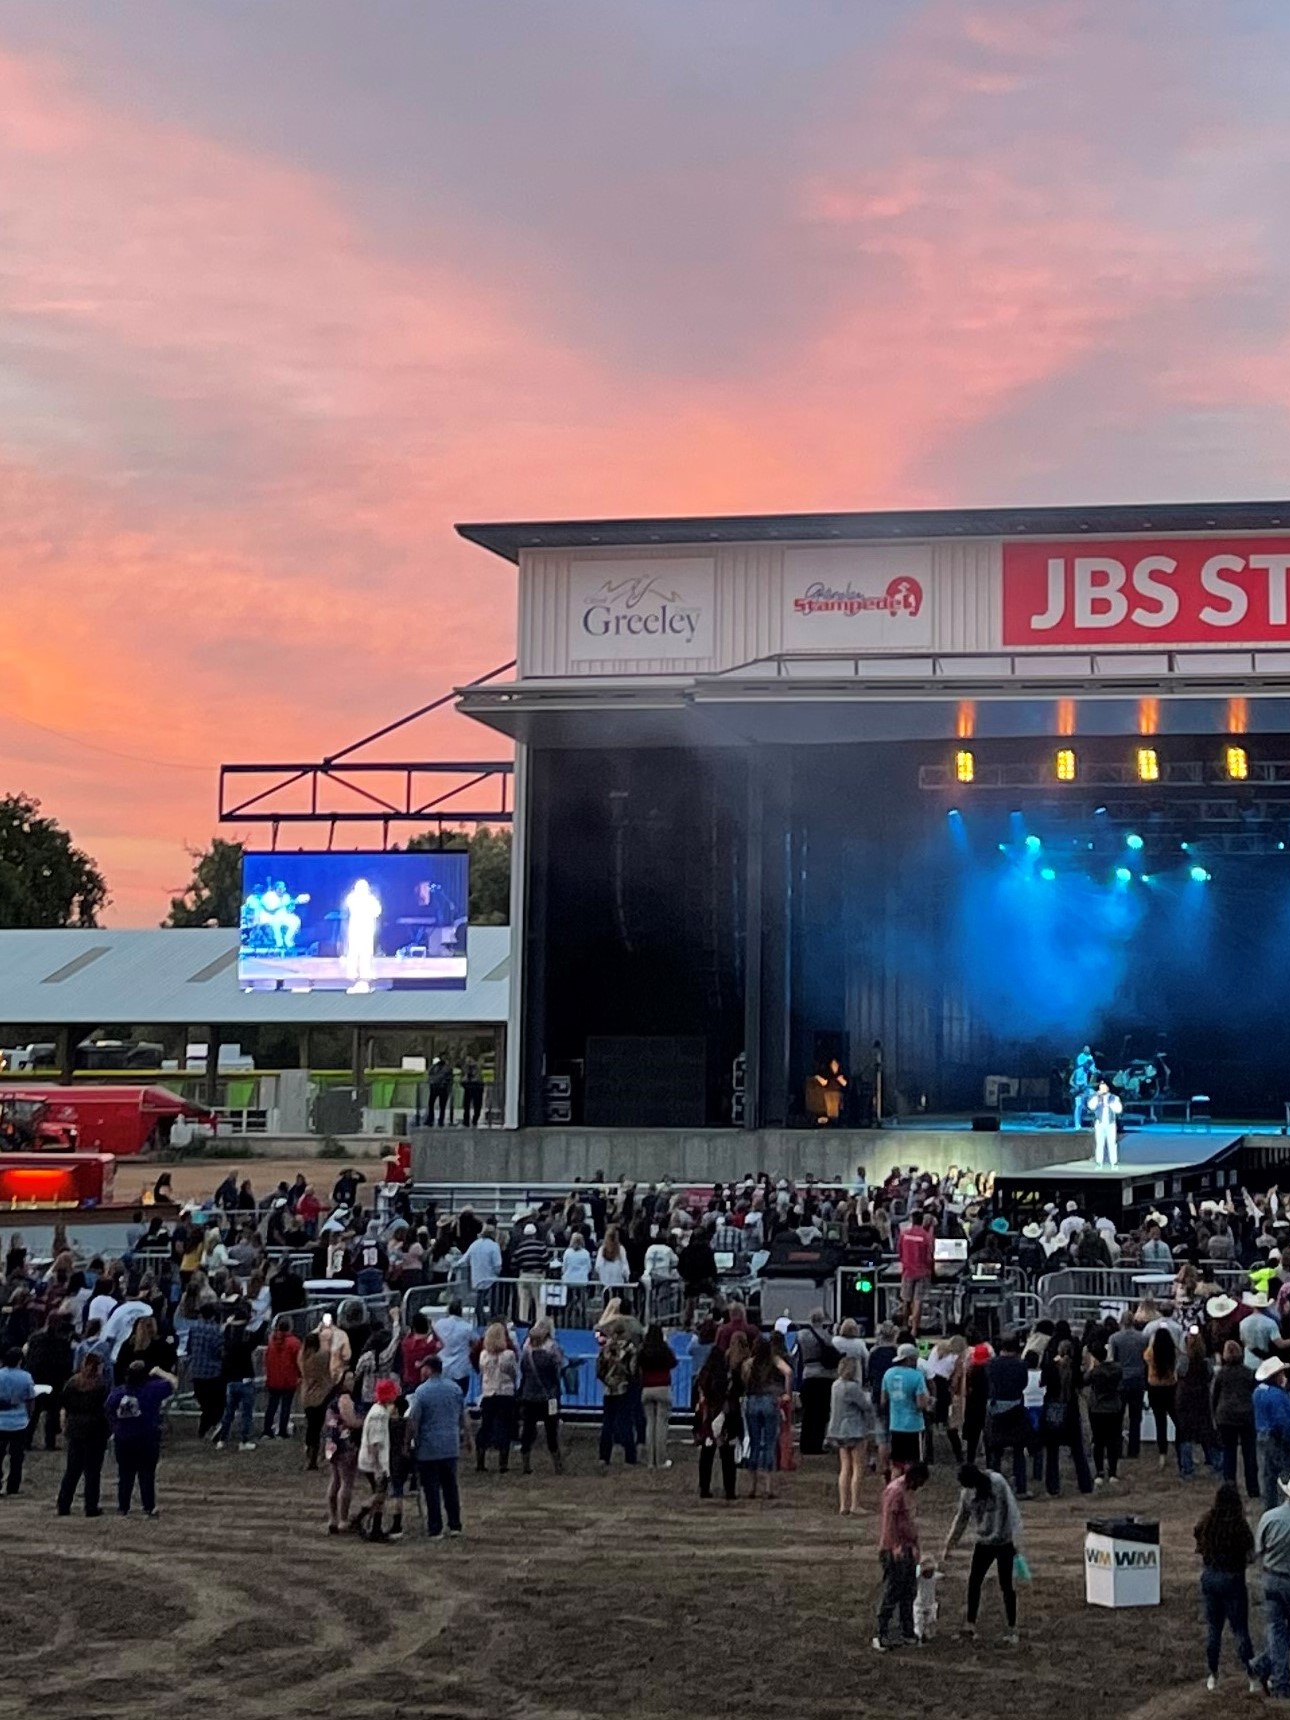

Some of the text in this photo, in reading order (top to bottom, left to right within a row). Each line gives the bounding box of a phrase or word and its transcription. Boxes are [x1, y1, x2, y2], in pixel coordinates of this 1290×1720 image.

[1030, 555, 1180, 630] JBS
[582, 604, 701, 643] Greeley
[1086, 1548, 1112, 1566] WM
[1115, 1550, 1157, 1566] WM
